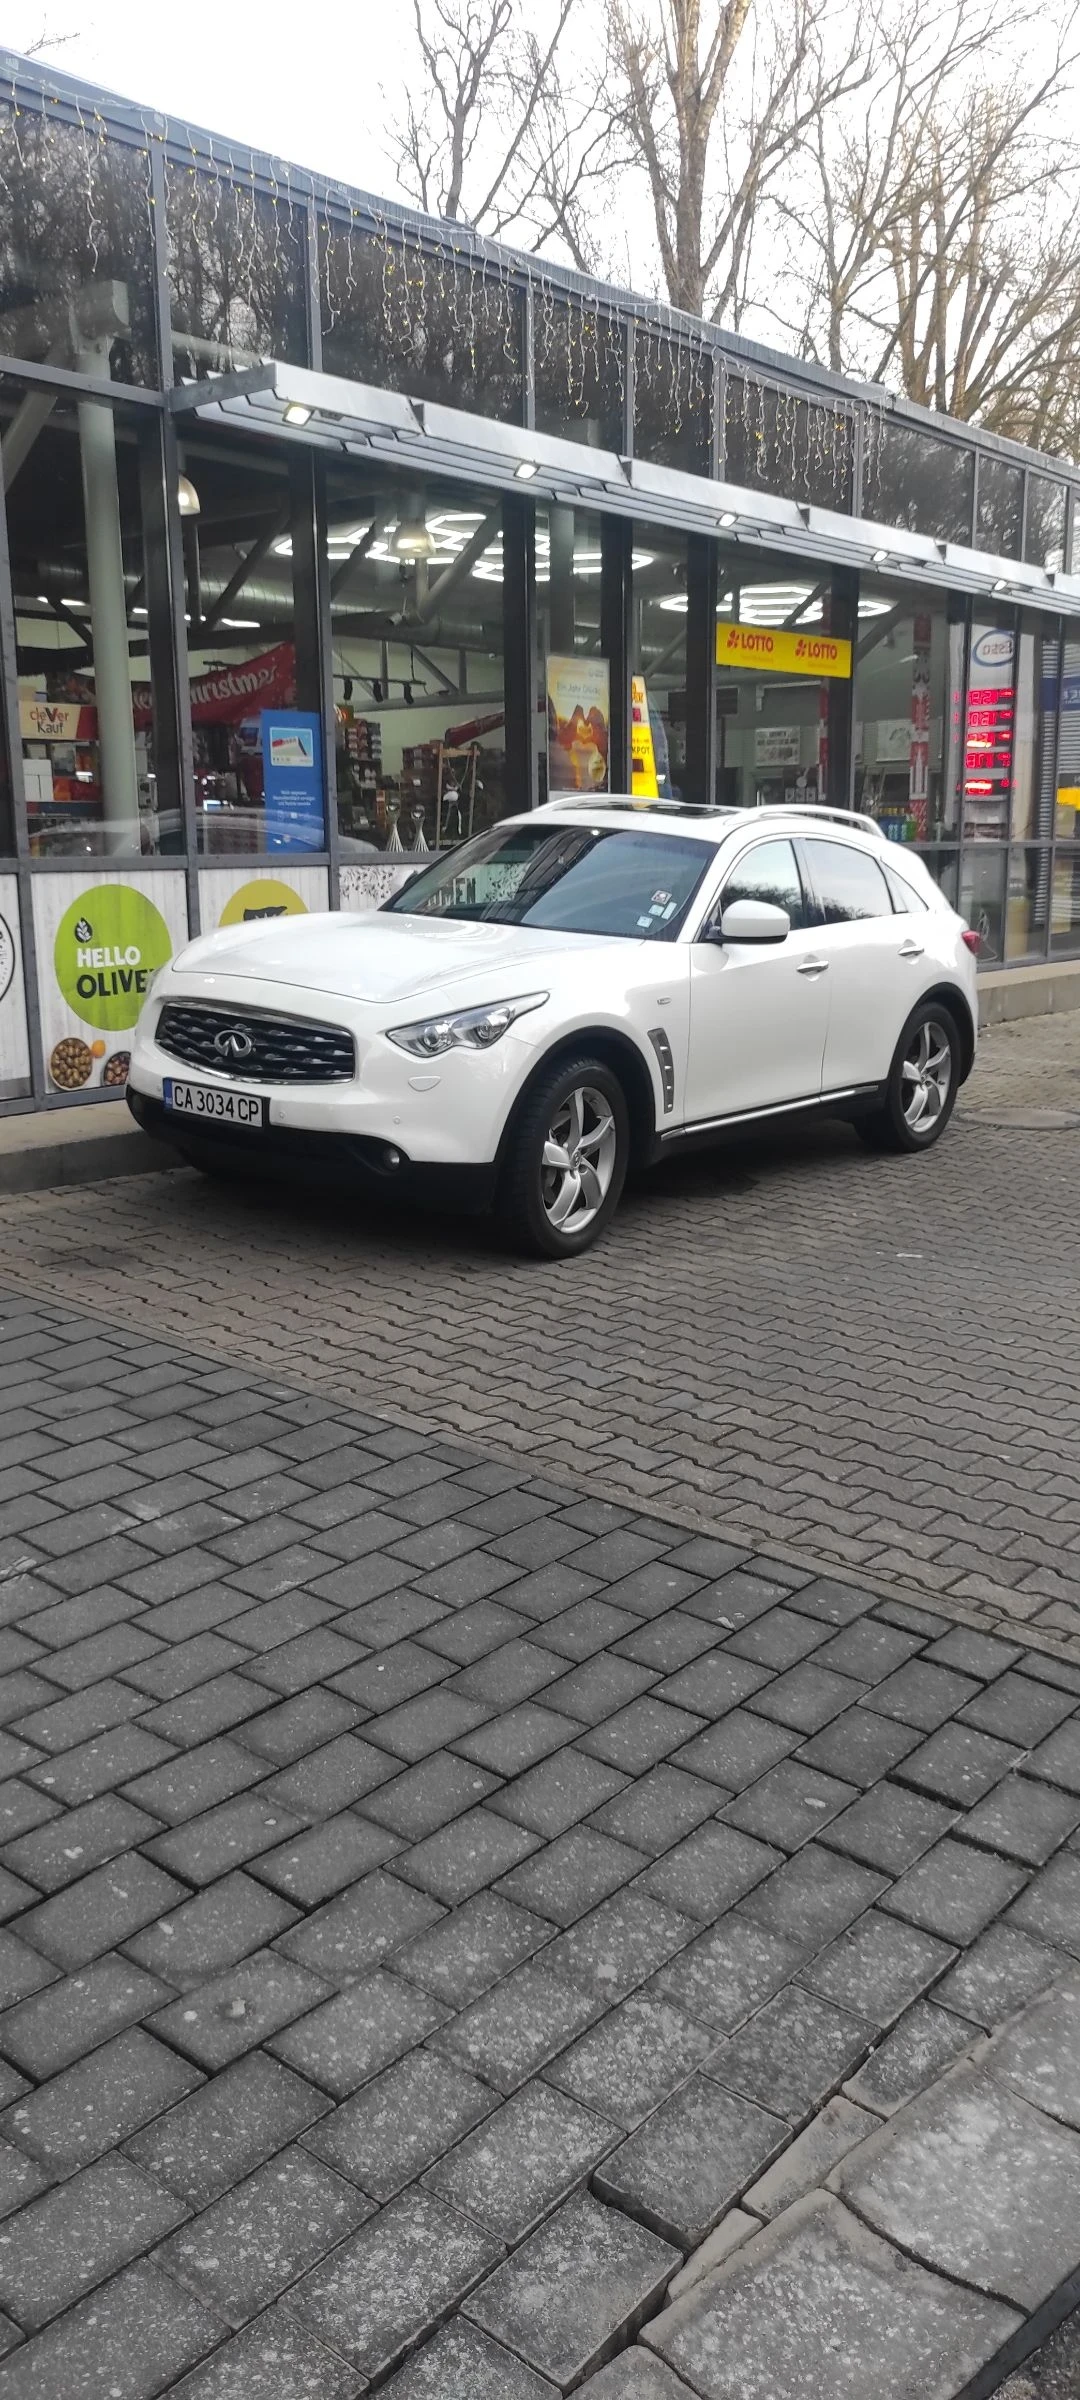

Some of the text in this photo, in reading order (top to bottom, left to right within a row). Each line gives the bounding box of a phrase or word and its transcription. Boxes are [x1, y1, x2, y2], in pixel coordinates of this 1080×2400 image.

[741, 633, 774, 653] LOTTO
[808, 643, 837, 660] LOTTO
[37, 721, 64, 734] Kauf
[76, 946, 141, 969] HELLO
[76, 969, 155, 999] OLIVE
[174, 1085, 194, 1110] CA
[196, 1090, 235, 1118] 3034
[237, 1098, 260, 1122] CP
